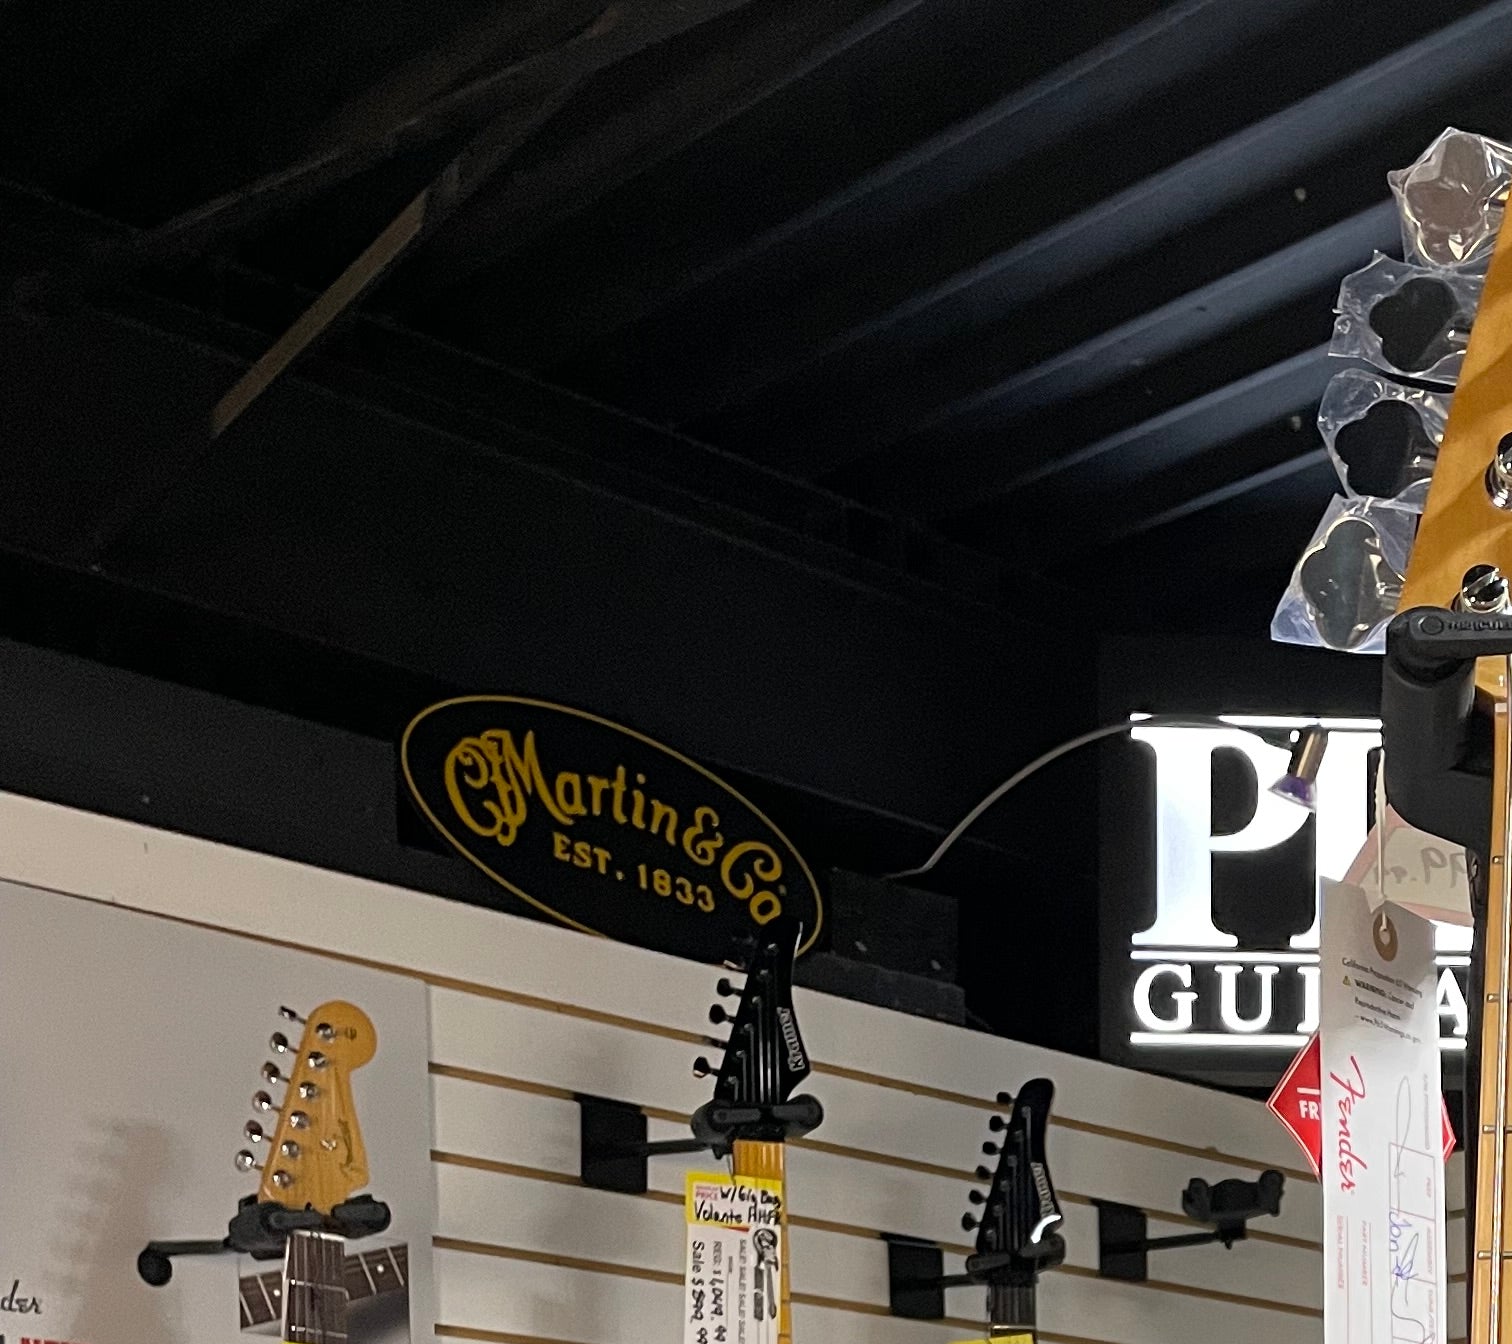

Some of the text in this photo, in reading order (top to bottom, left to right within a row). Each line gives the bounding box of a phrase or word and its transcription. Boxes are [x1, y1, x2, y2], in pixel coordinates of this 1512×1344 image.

[553, 830, 715, 912] EST. 1833
[776, 1005, 806, 1072] Kramer
[1330, 1056, 1367, 1191] Fender
[693, 1241, 704, 1273] Sale
